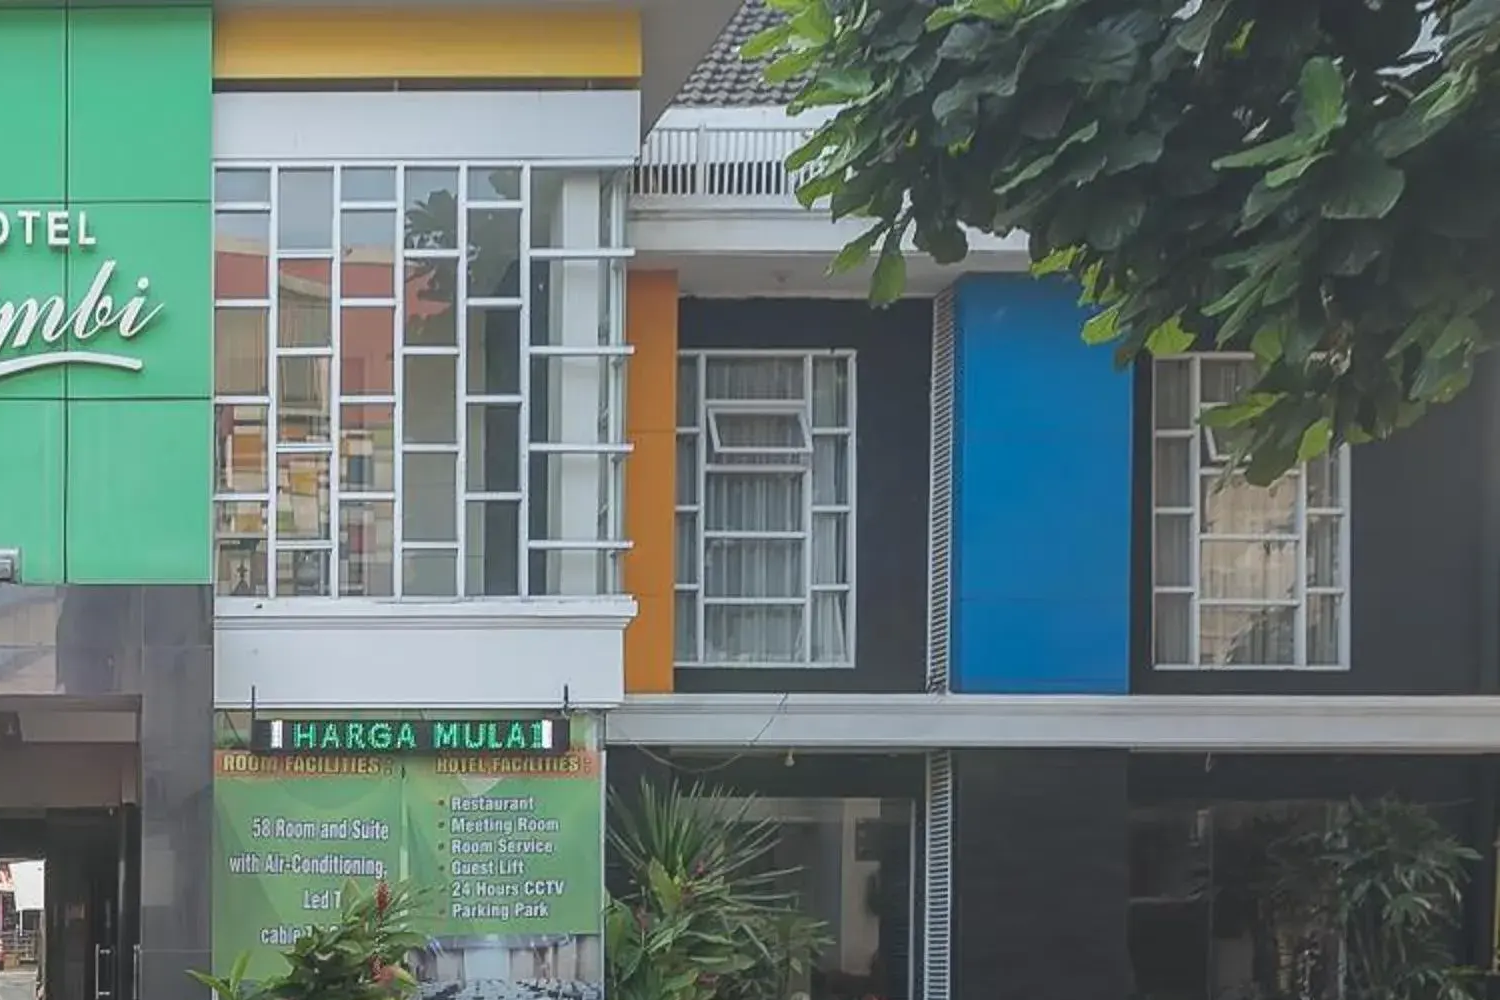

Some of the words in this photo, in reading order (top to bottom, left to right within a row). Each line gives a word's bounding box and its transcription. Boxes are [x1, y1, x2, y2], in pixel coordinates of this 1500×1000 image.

[293, 722, 417, 749] HARGA
[451, 797, 534, 811] Restaurant
[253, 817, 271, 838] 58
[275, 819, 315, 839] Room
[320, 820, 347, 839] and
[351, 819, 389, 841] Suite
[451, 817, 513, 834] Meeting
[517, 817, 560, 832] Room
[451, 839, 493, 854] Room
[497, 839, 554, 854] Service
[229, 854, 260, 874] with
[451, 860, 495, 875] Guest
[499, 860, 524, 875] Lift
[452, 881, 470, 897] 24
[476, 881, 520, 897] Hours
[524, 879, 565, 896] CCTV
[303, 890, 329, 910] Led
[452, 902, 509, 920] Parking
[515, 902, 549, 918] Park
